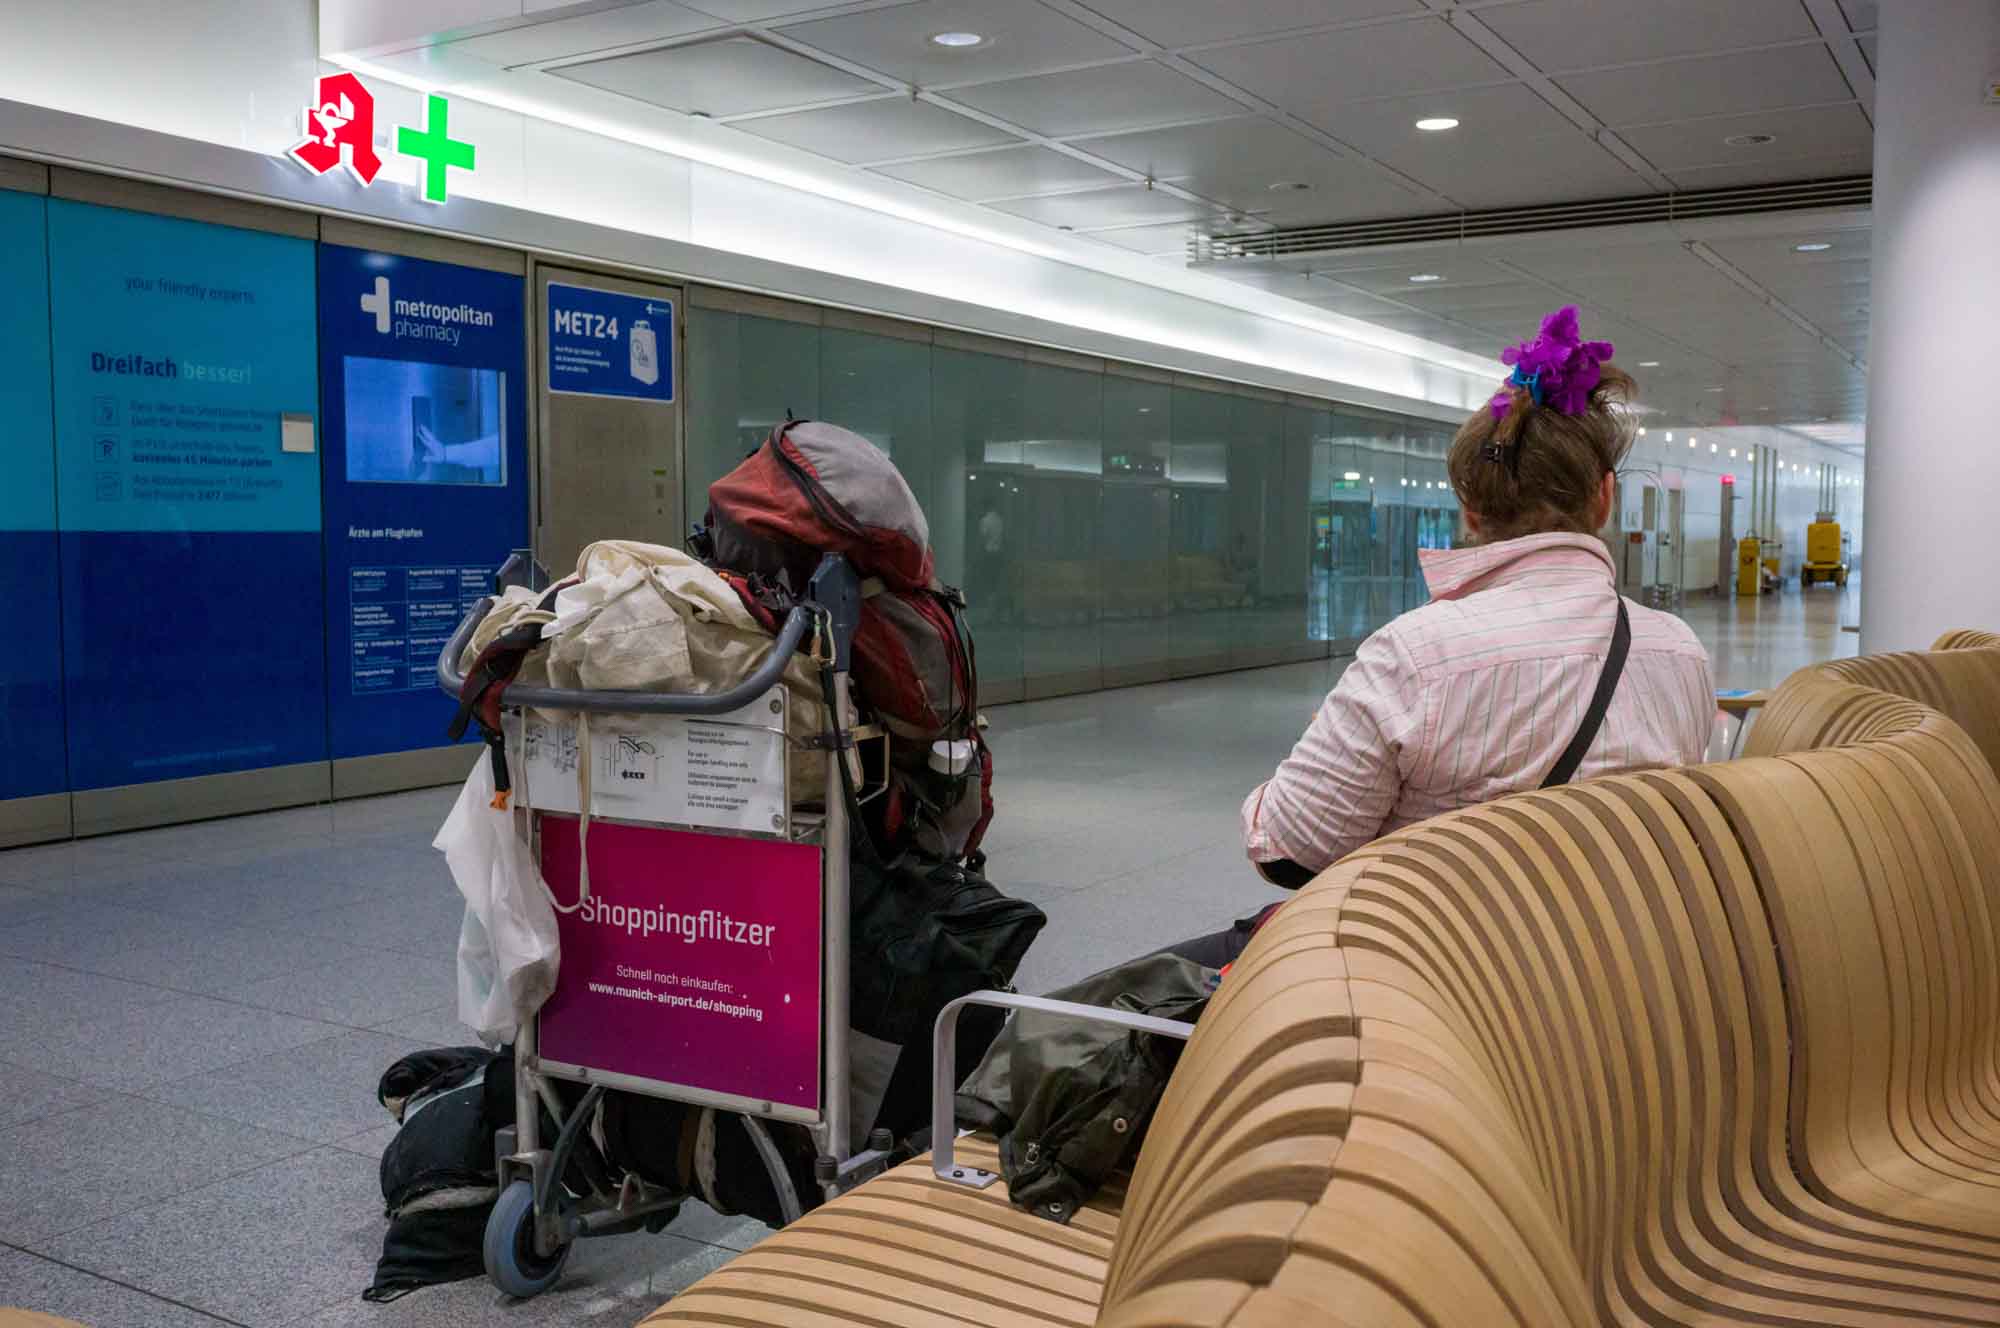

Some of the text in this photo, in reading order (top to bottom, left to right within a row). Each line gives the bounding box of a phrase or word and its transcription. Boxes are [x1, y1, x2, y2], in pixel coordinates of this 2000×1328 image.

[395, 299, 494, 327] metropolitan
[554, 309, 619, 340] MET24
[395, 318, 461, 347] pharmacy
[91, 351, 177, 379] Dreifach
[348, 525, 424, 540] Ärzte am Flughafen
[580, 896, 775, 947] Shoppingflitzer
[616, 964, 734, 994] Schnell noch einkaufen:
[588, 981, 764, 1022] www.munich-airport.de/shopping
